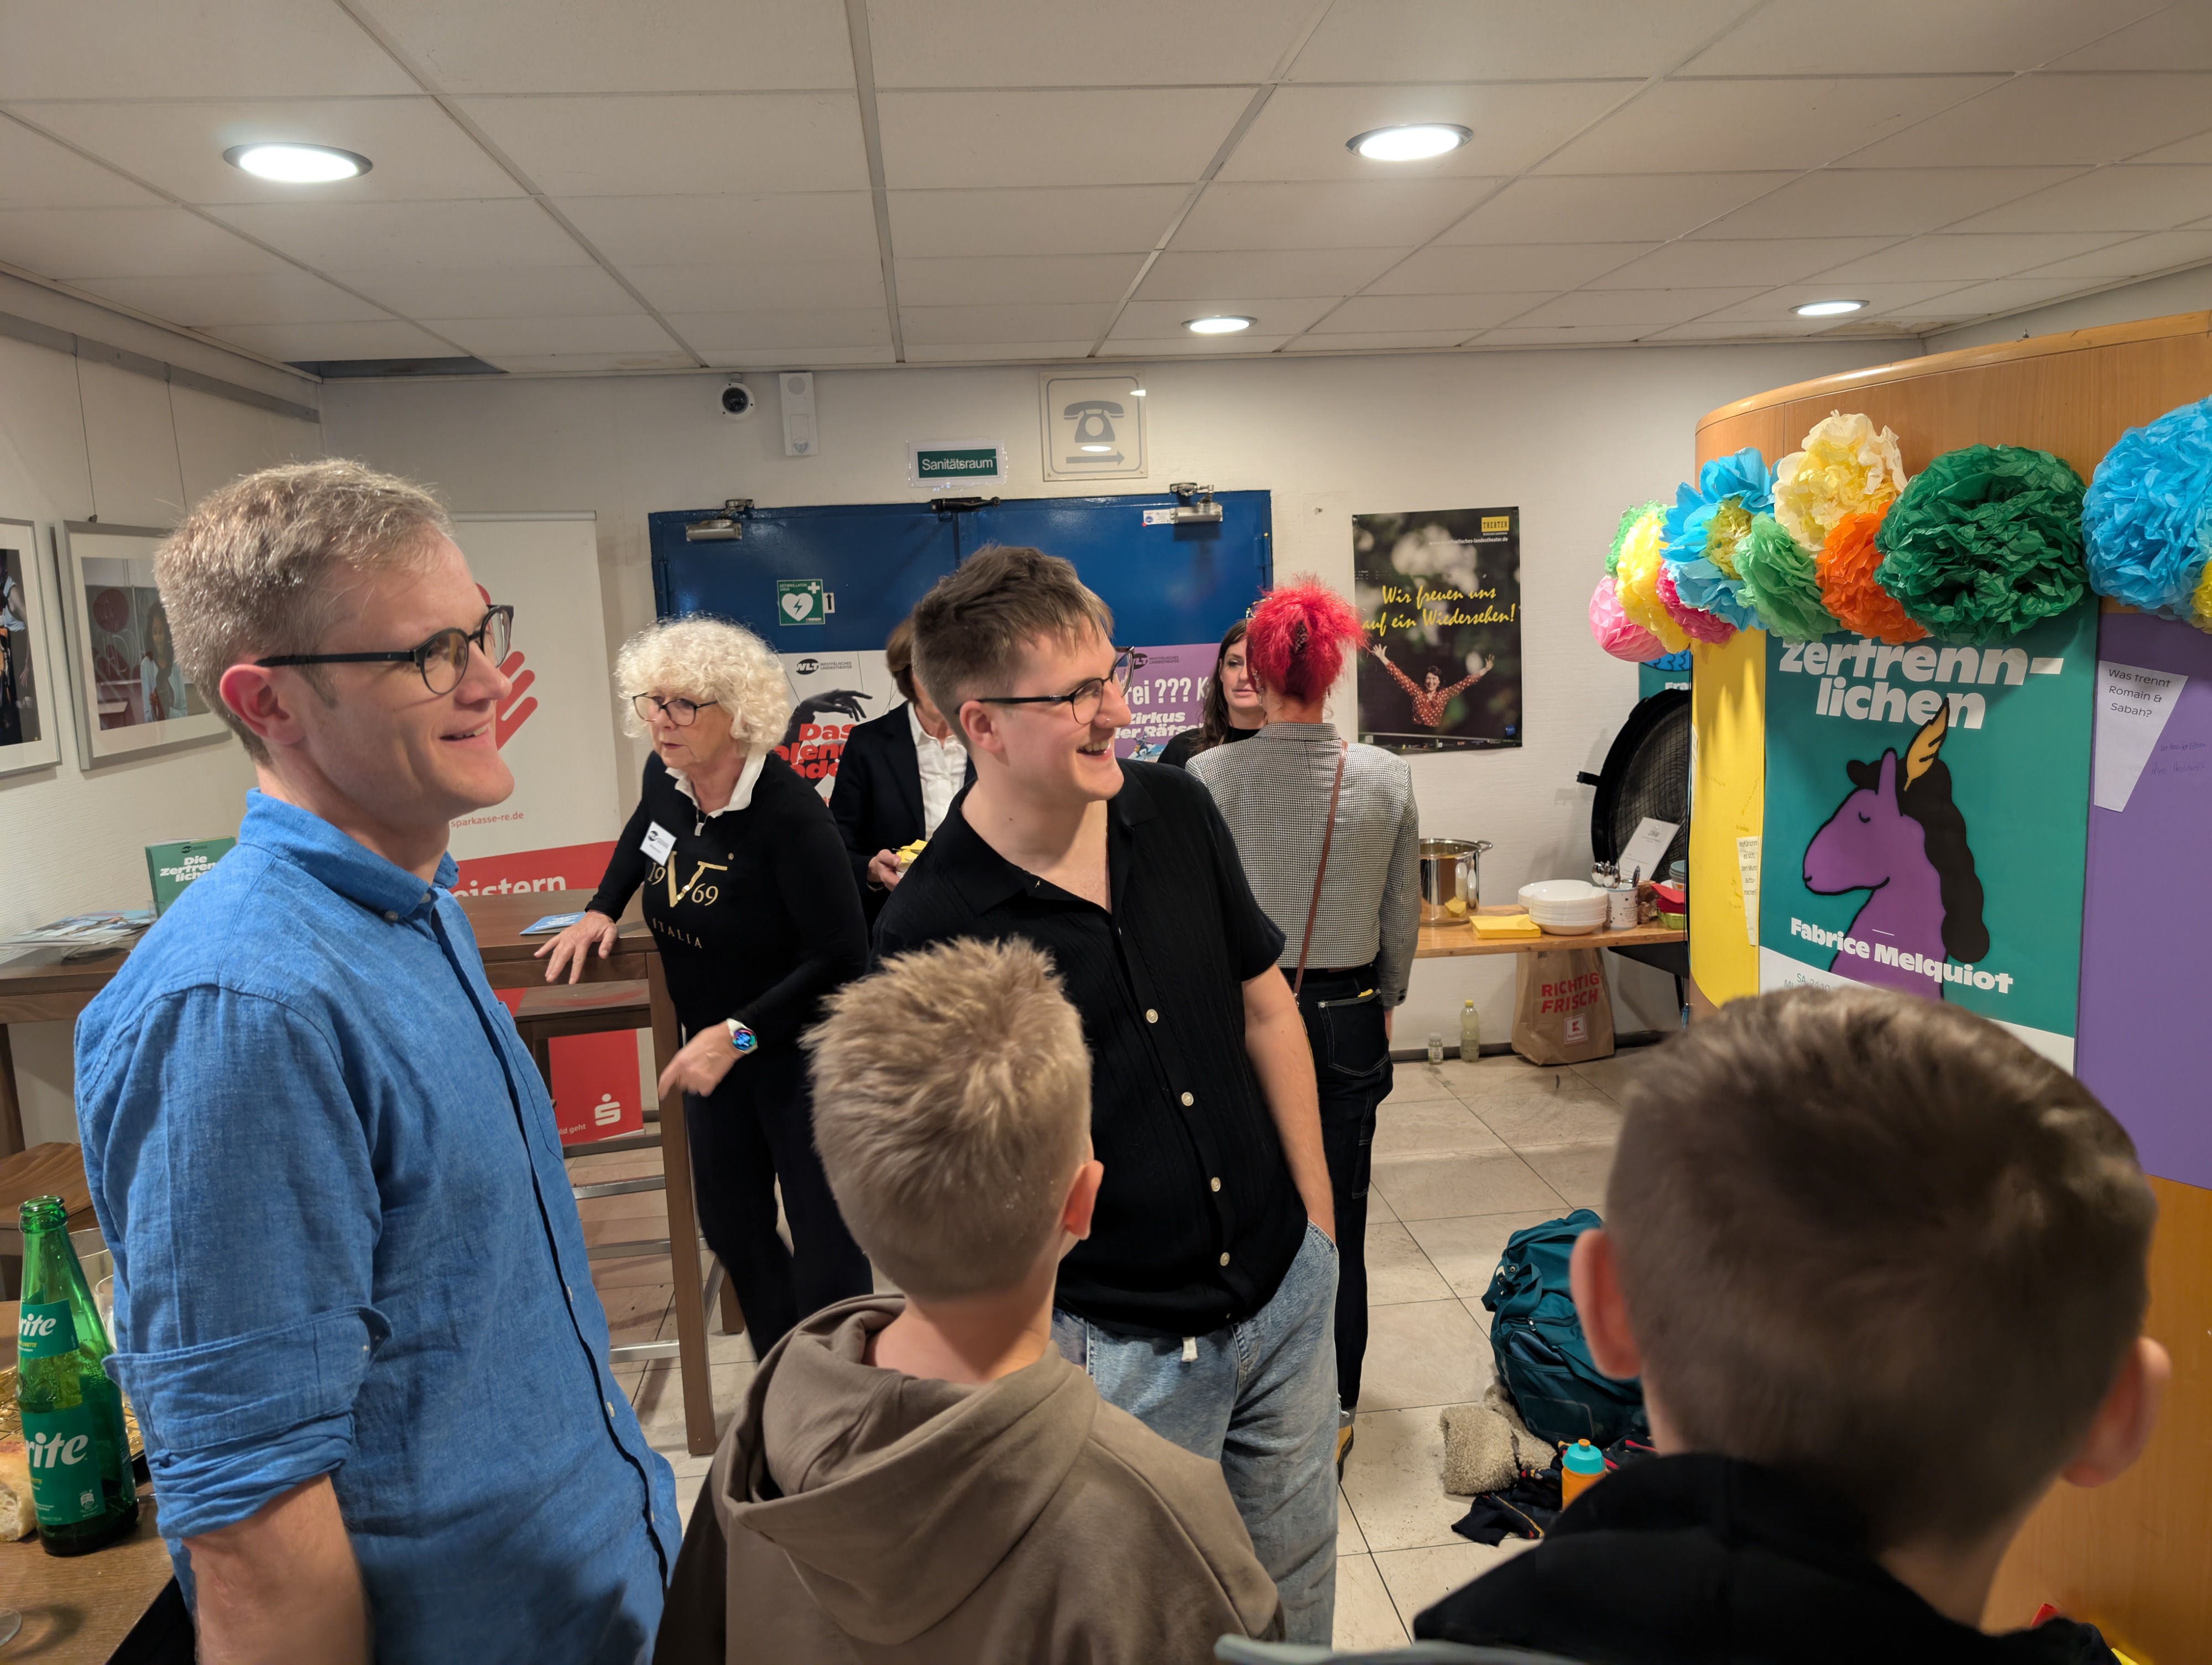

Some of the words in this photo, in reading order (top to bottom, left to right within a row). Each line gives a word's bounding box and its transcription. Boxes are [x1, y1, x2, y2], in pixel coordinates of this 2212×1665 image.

[921, 458, 993, 471] Sanitätsraum
[1483, 521, 1508, 529] THEATER
[1382, 584, 1412, 604] Wir
[1416, 584, 1464, 610] freuen
[1468, 587, 1496, 599] uns
[1361, 612, 1387, 636] auf
[1391, 613, 1417, 628] ein
[1422, 603, 1516, 627] Wiedersehen!
[2109, 669, 2132, 681] Was
[2134, 674, 2172, 687] trennt
[1125, 680, 1150, 705] rei
[1154, 677, 1192, 703] ???
[2108, 685, 2151, 701] Romain
[2153, 694, 2163, 703] &
[1815, 676, 1986, 729] lichen
[2110, 702, 2152, 718] Sabah?
[450, 811, 525, 828] sparkasse-re.de
[184, 855, 208, 866] Die
[175, 871, 207, 882] lich
[691, 883, 719, 906] 69
[651, 917, 703, 949] ITALIA
[1791, 917, 1870, 959] Fabrice
[1874, 943, 2013, 994] Melquiot
[1541, 972, 1600, 997] RICHTIG
[1541, 988, 1599, 1014] FRISCH
[569, 1124, 586, 1135] geht
